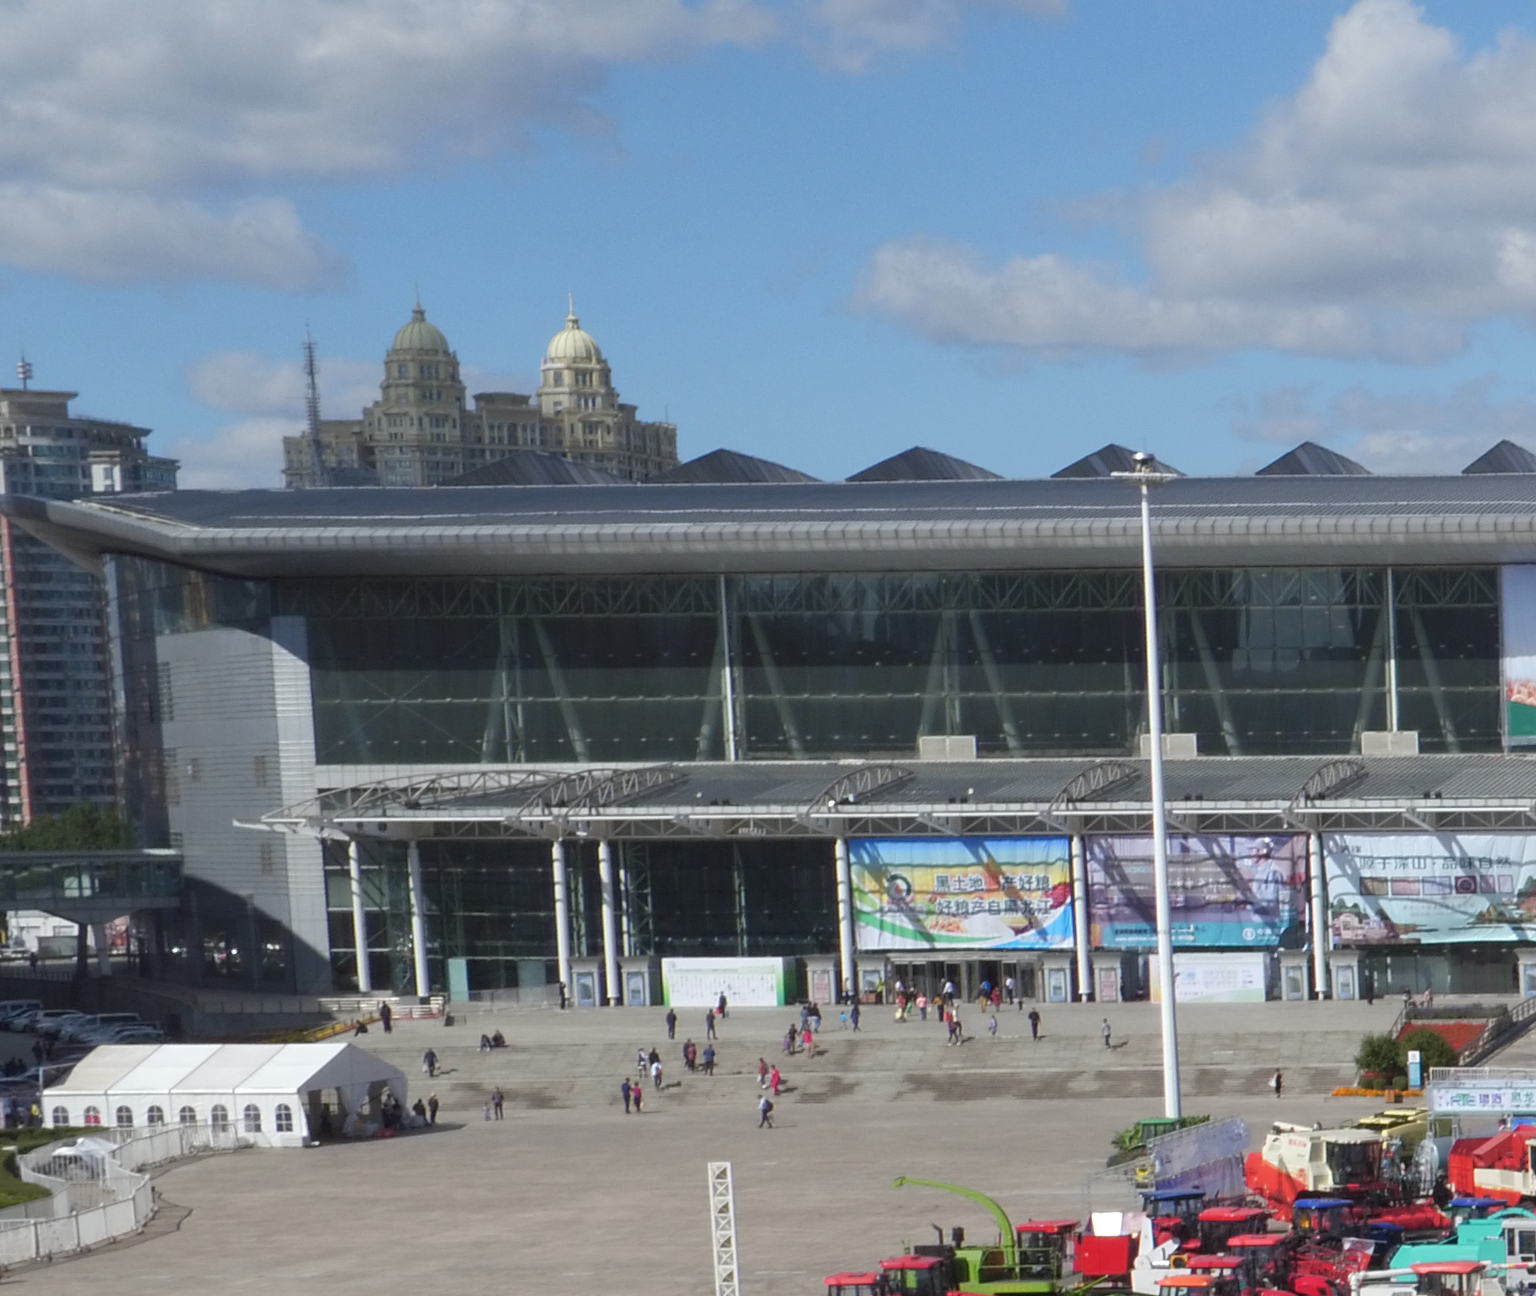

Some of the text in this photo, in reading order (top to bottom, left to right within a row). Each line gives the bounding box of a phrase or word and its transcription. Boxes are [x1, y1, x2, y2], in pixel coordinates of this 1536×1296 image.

[935, 875, 1050, 891] 黑土地 产好粮
[936, 899, 1052, 915] 好粮产自黑龙江
